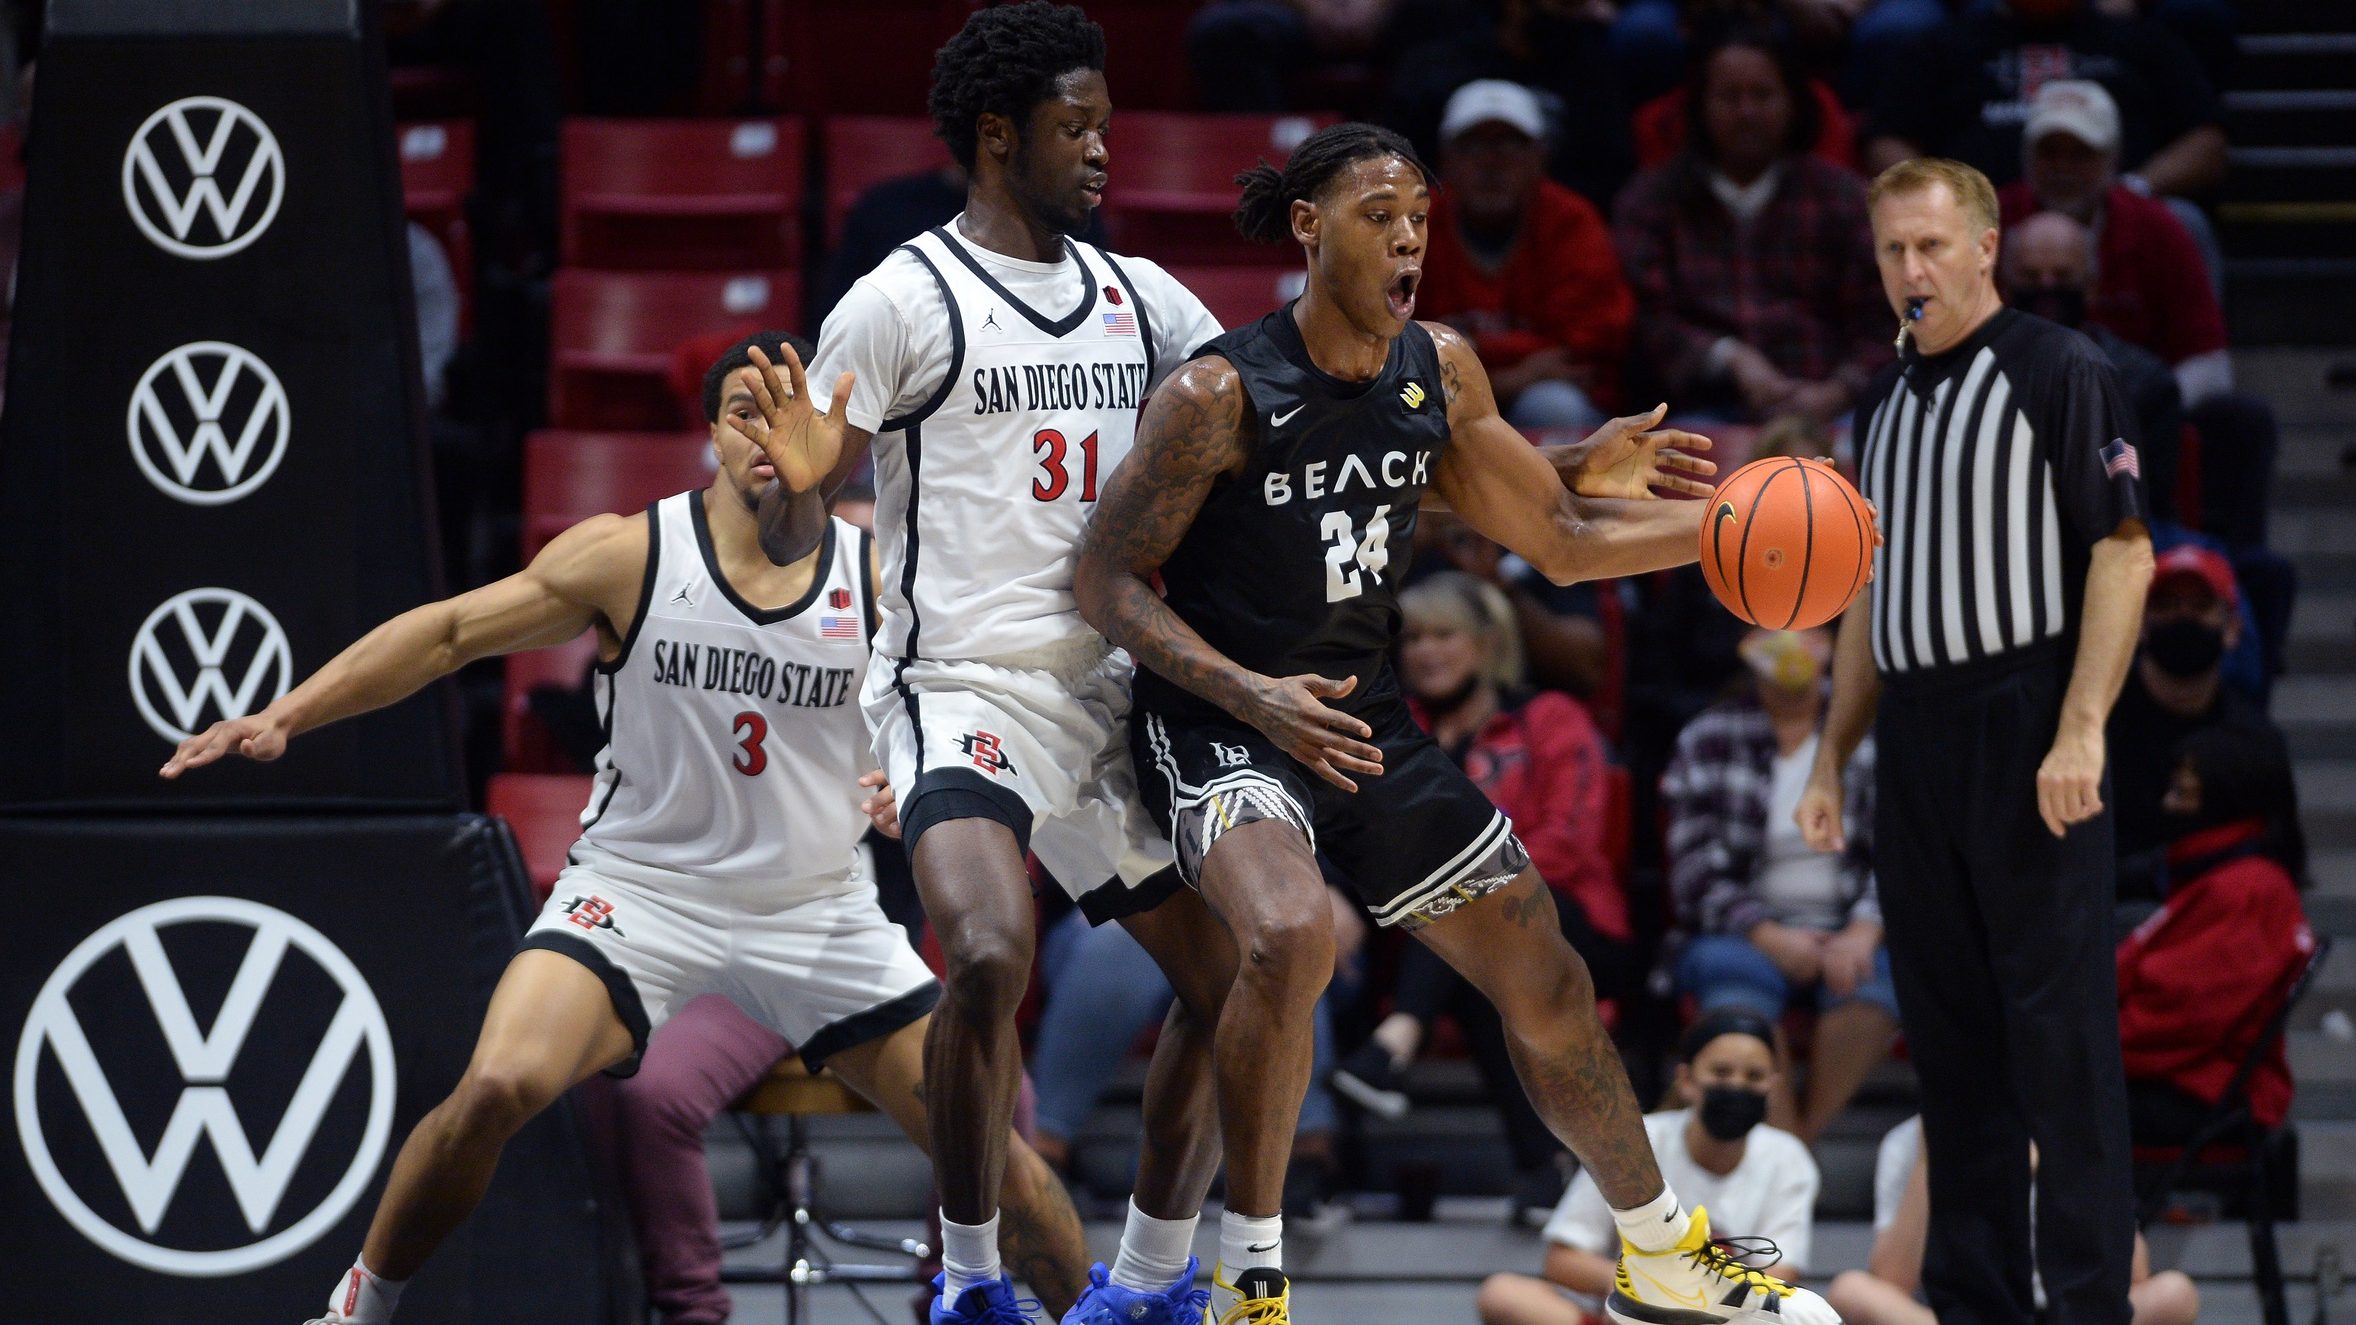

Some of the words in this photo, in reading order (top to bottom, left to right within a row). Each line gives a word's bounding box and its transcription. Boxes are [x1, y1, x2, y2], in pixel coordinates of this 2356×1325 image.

[127, 101, 281, 244] VW
[132, 346, 286, 489] VW
[974, 366, 1019, 415] SAN
[1022, 362, 1088, 411] DIEGO
[1032, 428, 1098, 502] 31
[1264, 450, 1431, 506] BEACH
[1320, 504, 1391, 602] 24
[133, 592, 288, 733] VW
[654, 638, 700, 688] SAN
[702, 645, 776, 699] DIEGO
[776, 661, 854, 708] STATE
[733, 711, 768, 776] 3
[24, 905, 387, 1246] VW
